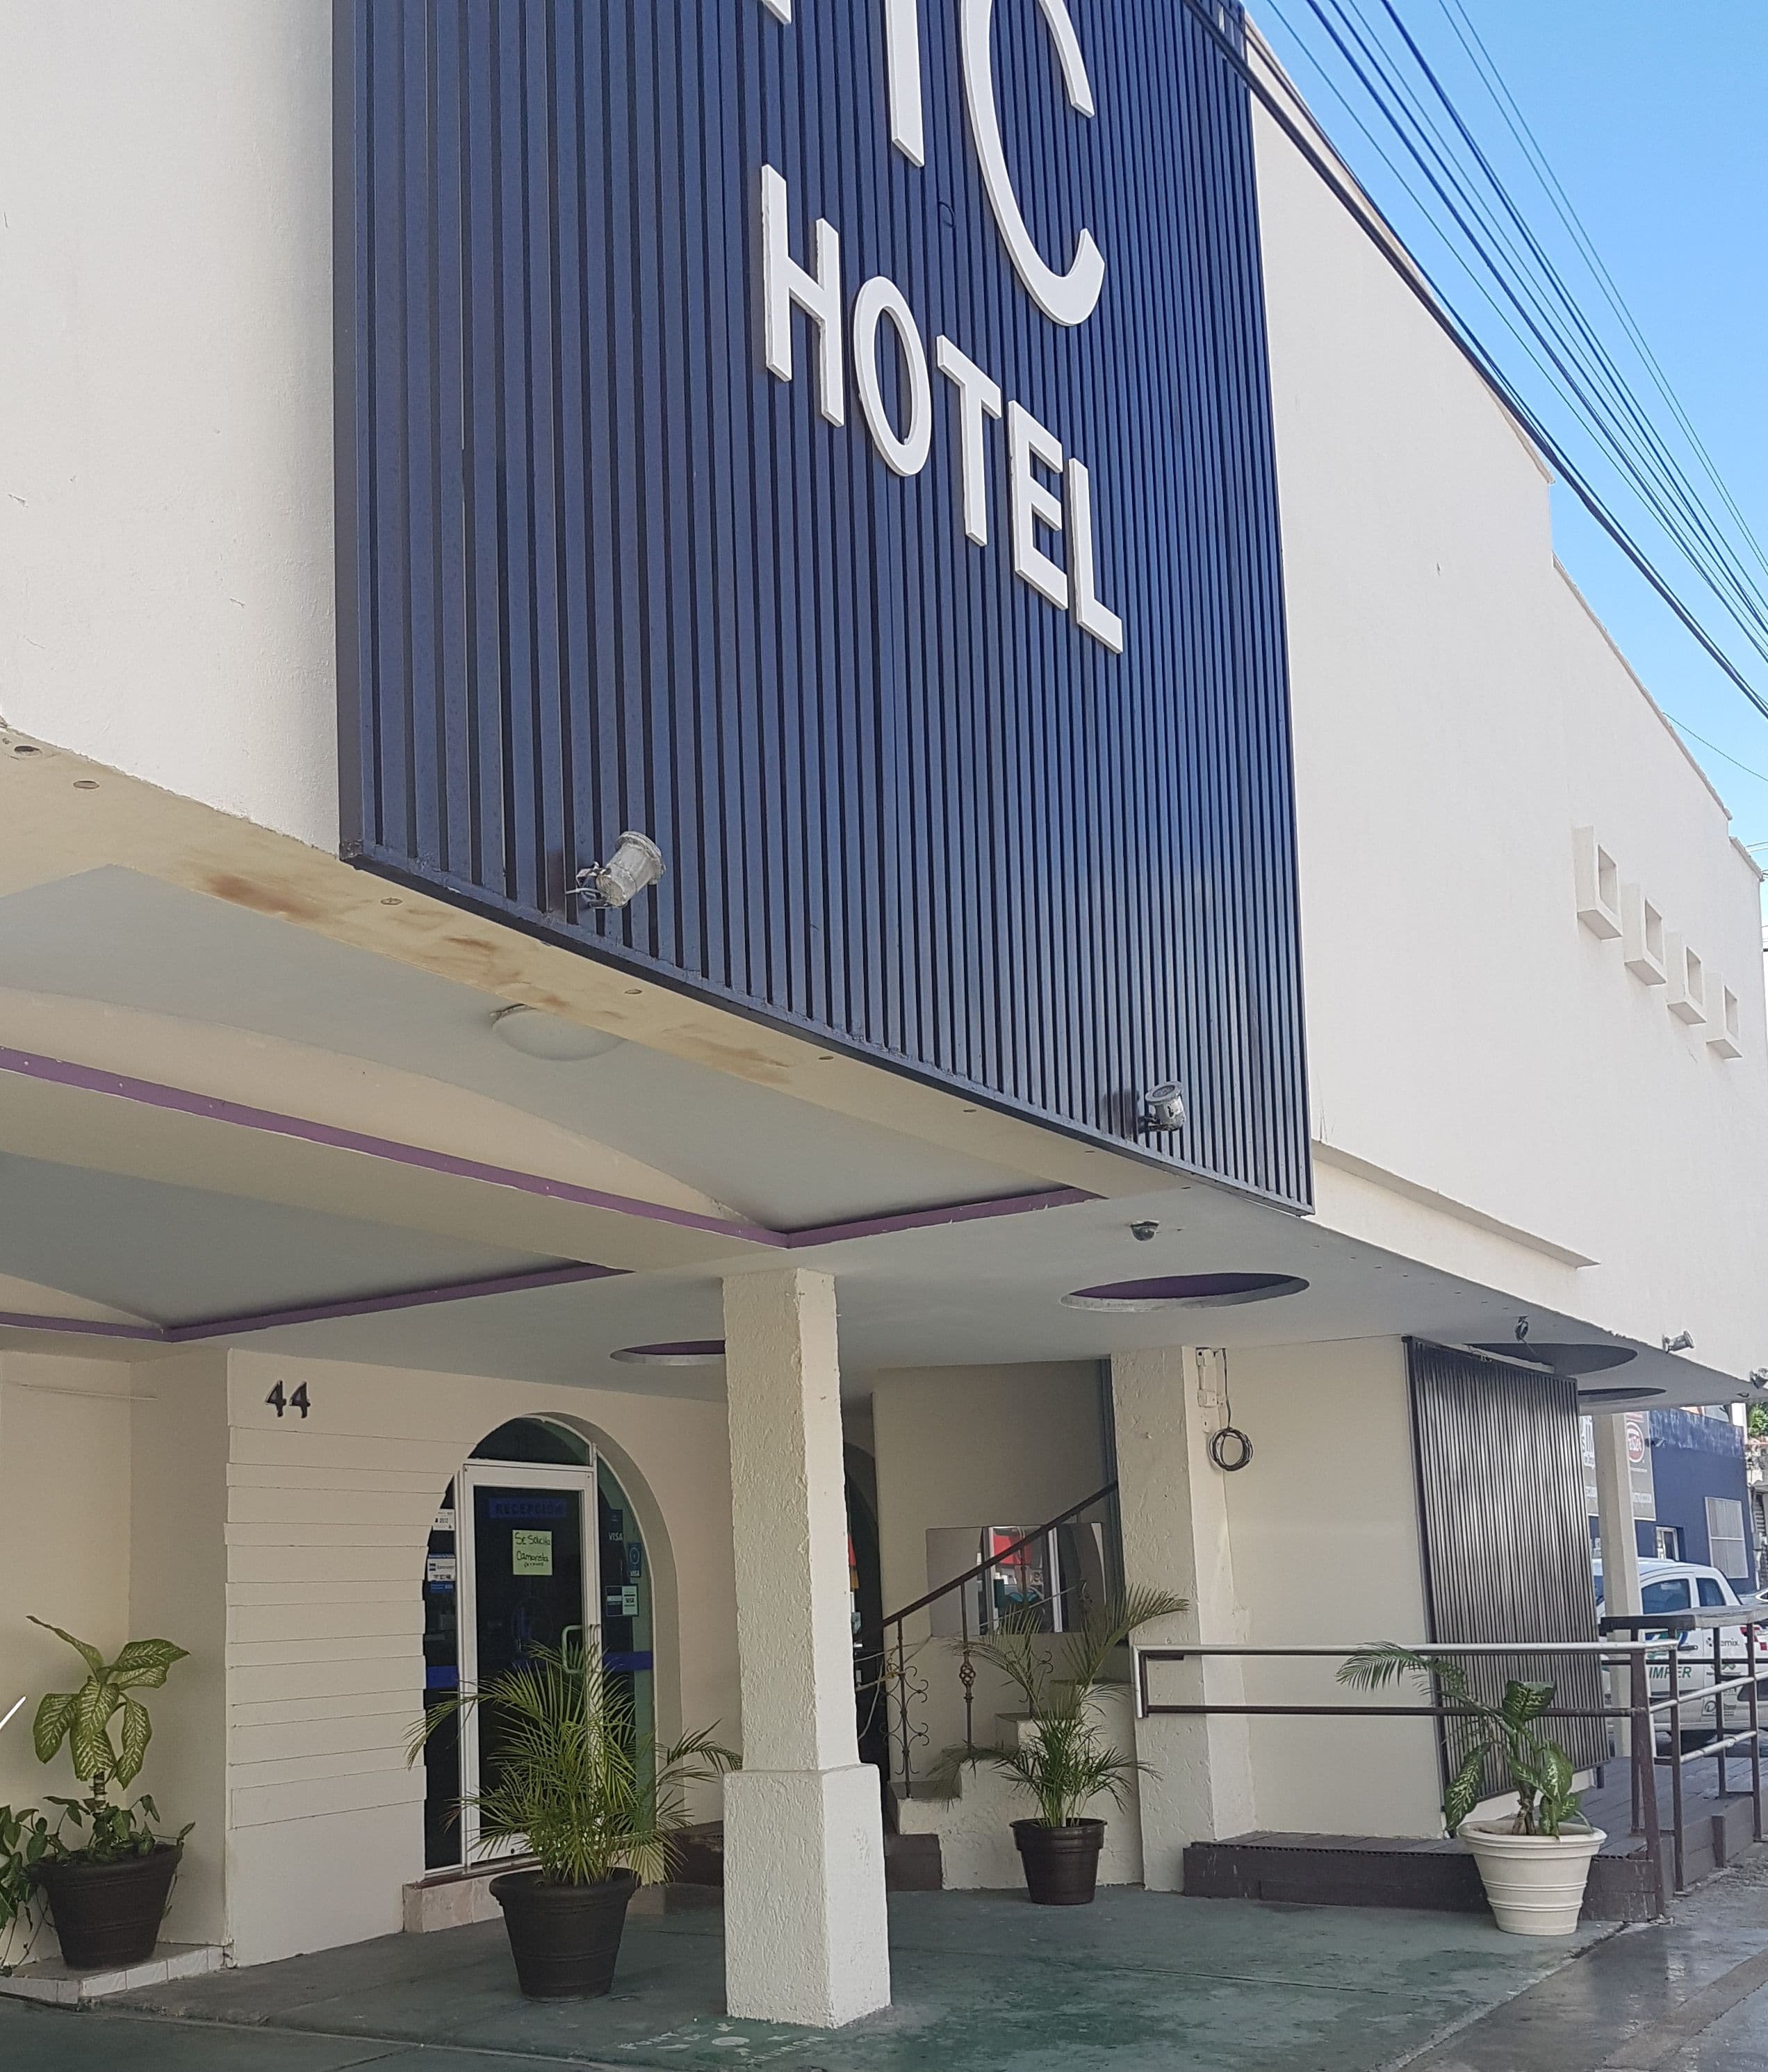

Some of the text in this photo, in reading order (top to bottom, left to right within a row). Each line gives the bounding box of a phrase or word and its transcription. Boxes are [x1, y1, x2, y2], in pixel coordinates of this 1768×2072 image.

[762, 164, 1123, 654] HOTEL
[265, 1380, 311, 1418] 44
[608, 1532, 623, 1541] VISA
